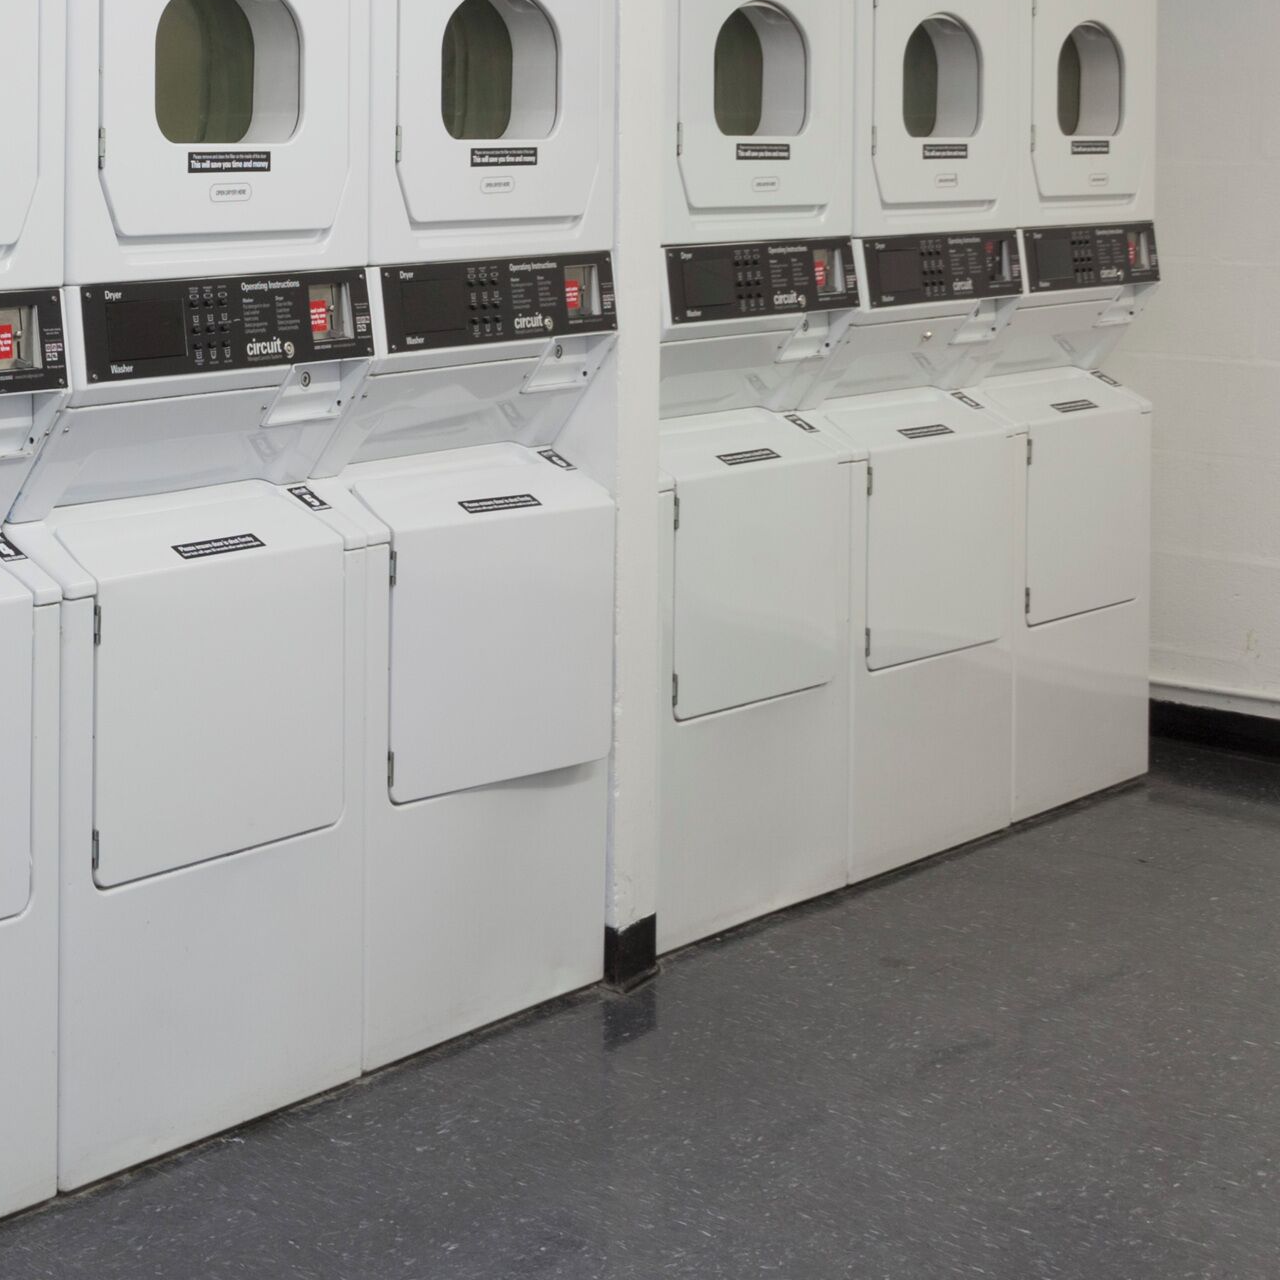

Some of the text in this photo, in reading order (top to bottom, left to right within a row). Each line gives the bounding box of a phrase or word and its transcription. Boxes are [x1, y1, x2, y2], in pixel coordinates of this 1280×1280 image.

[105, 290, 122, 301] Dryer
[515, 312, 543, 329] circuit
[247, 336, 282, 355] circuit
